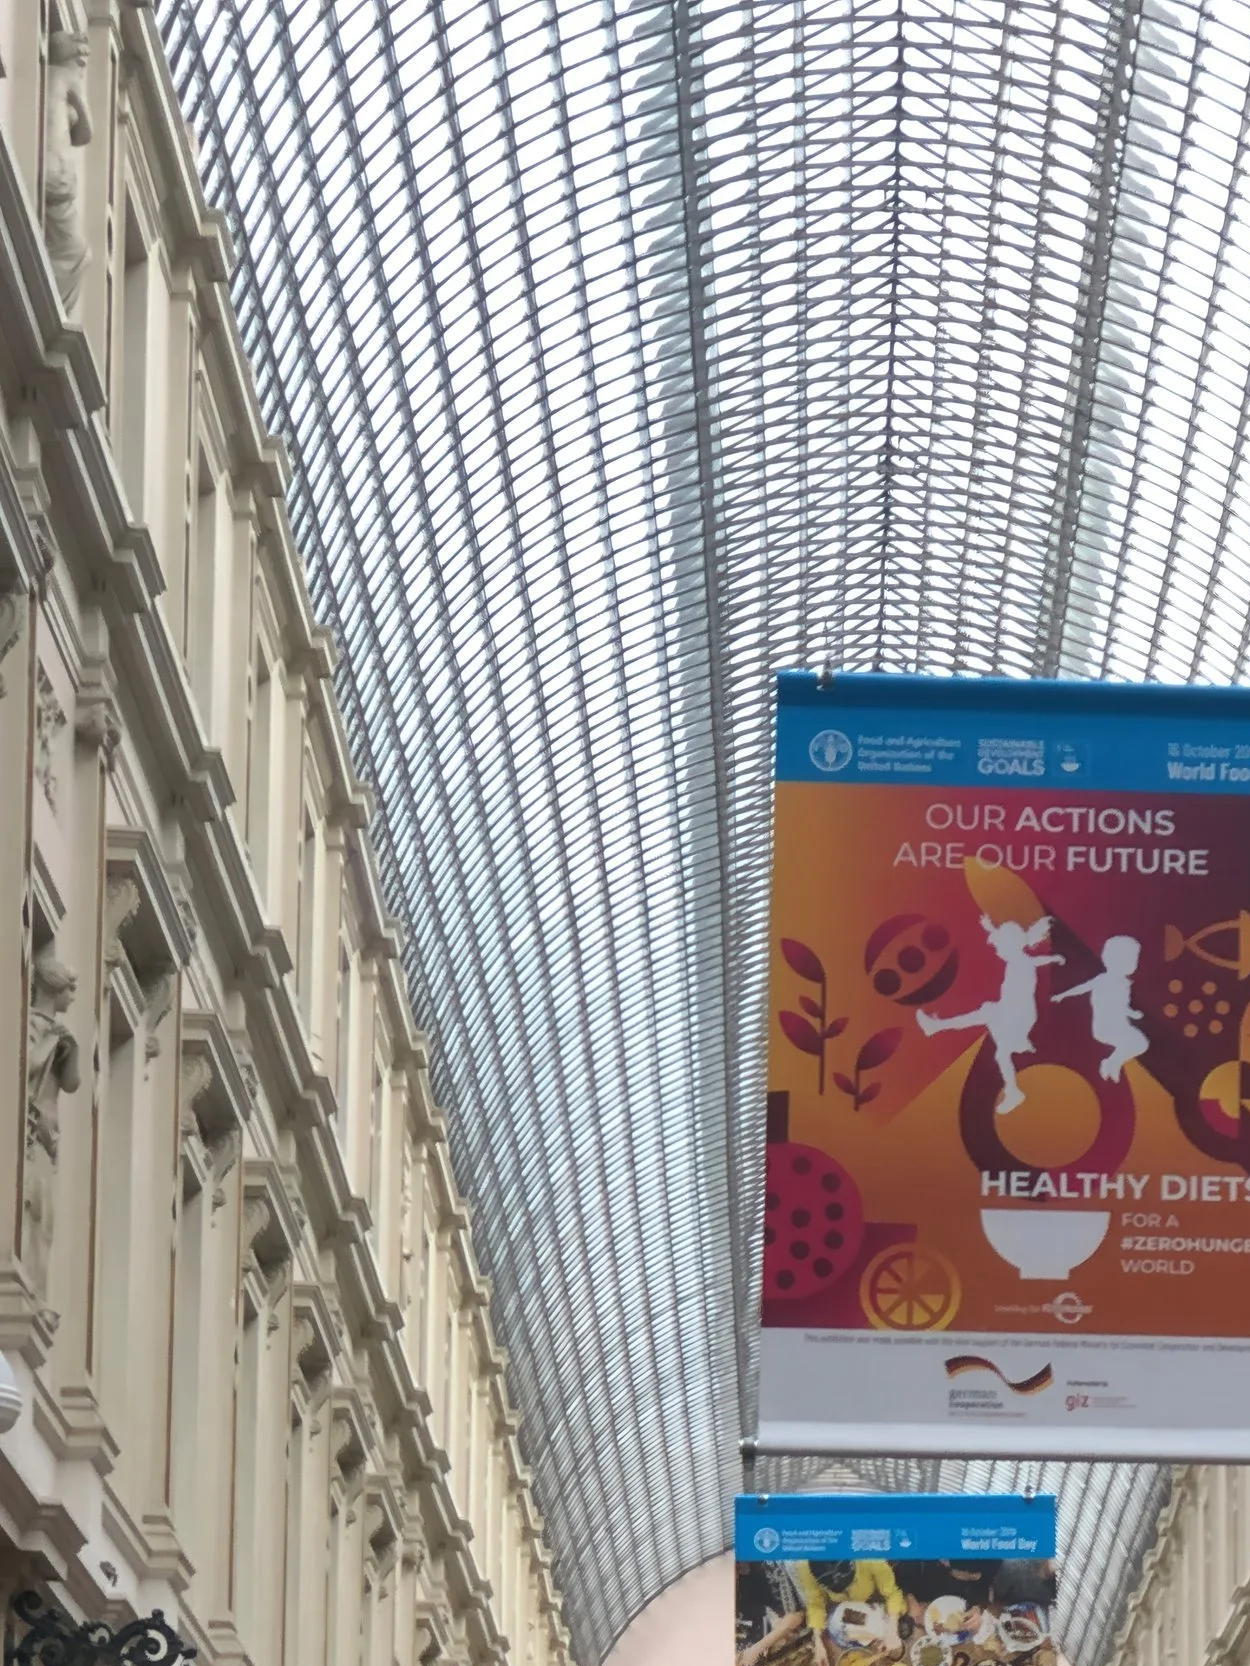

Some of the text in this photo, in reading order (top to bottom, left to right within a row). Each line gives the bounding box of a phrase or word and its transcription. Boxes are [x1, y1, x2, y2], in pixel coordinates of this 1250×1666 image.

[1183, 744, 1231, 759] October
[977, 758, 1046, 775] GOALS
[1167, 762, 1216, 781] World
[926, 803, 1176, 836] OUR ACTIONS
[893, 842, 1210, 876] ARE OUR FUTURE
[980, 1170, 1151, 1200] HEALTHY
[1122, 1213, 1180, 1229] FOR A
[1121, 1259, 1196, 1275] WORLD
